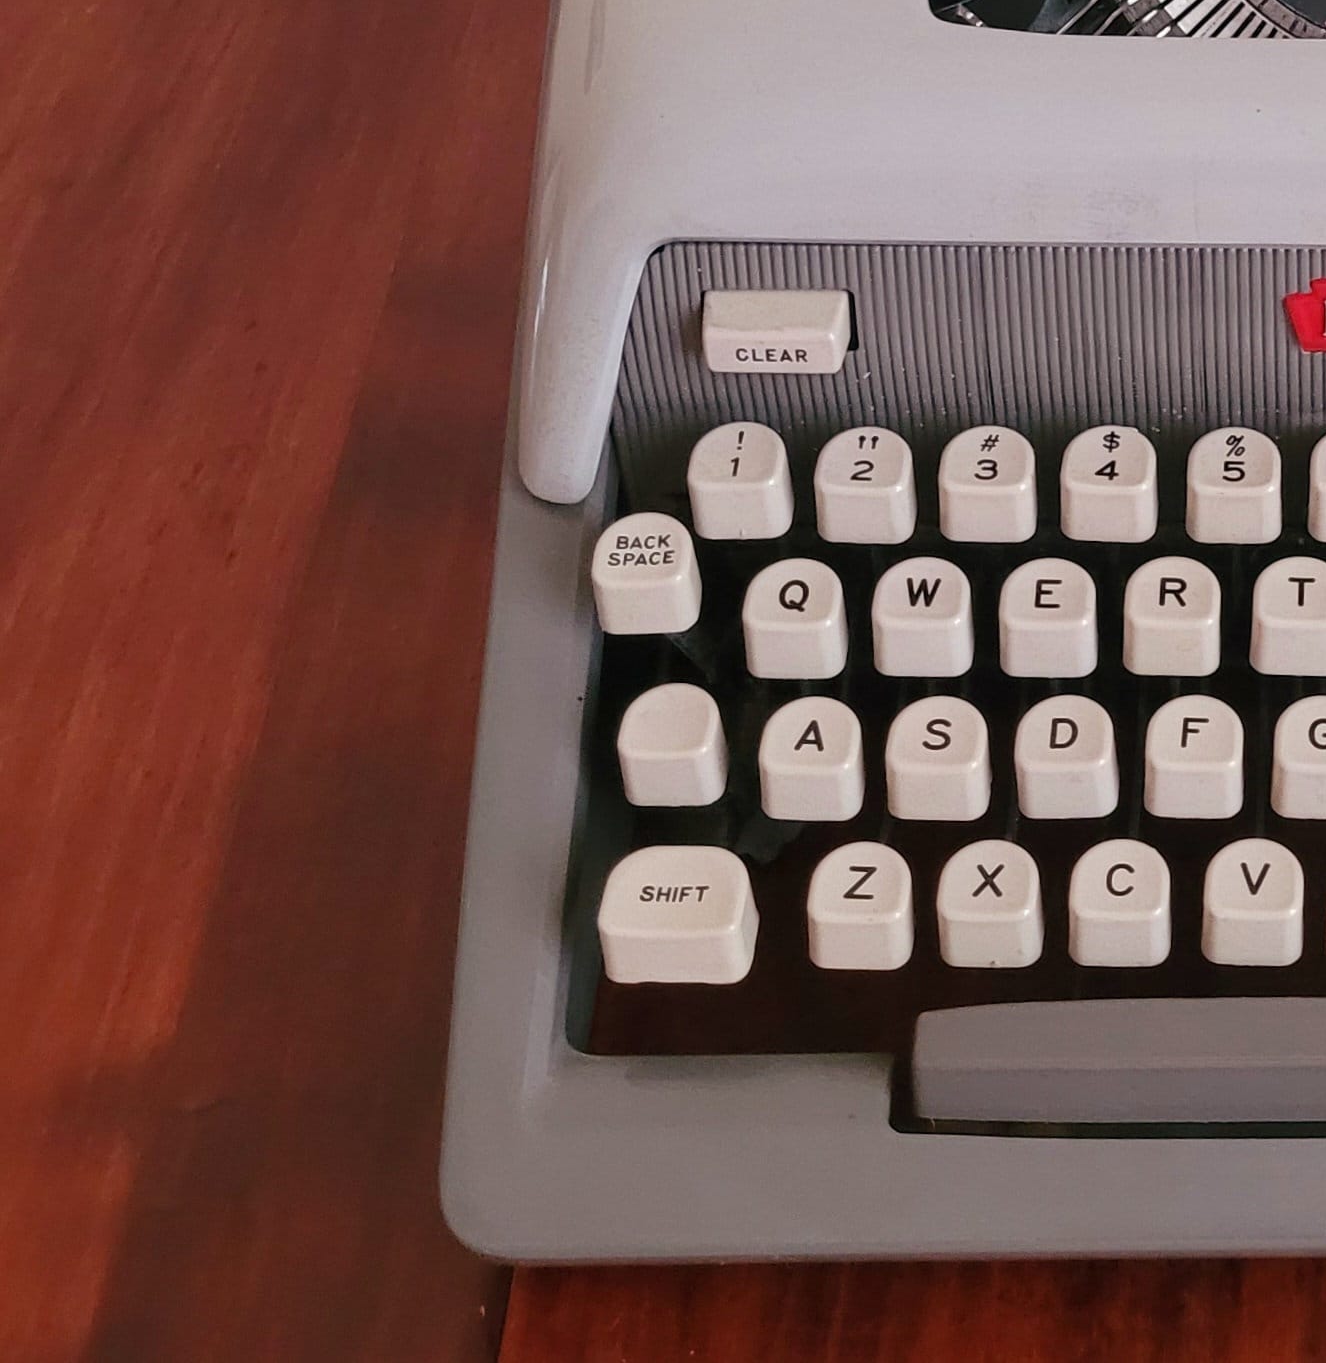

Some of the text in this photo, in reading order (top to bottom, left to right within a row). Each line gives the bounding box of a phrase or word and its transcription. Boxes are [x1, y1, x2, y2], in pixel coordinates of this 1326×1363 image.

[735, 348, 808, 363] CLEAR
[736, 430, 745, 451] !
[980, 434, 1000, 452] #
[1102, 430, 1121, 453] $
[1225, 434, 1246, 457] %
[730, 457, 740, 477] 1
[850, 460, 875, 482] 2
[974, 459, 998, 481] 3
[1094, 460, 1120, 481] 4
[1222, 460, 1246, 483] 5
[615, 534, 671, 549] BACK
[607, 550, 676, 567] SPACE
[778, 579, 810, 613] Q
[906, 577, 942, 608] W
[1034, 579, 1063, 609] E
[1158, 577, 1188, 608] R
[1287, 577, 1316, 607] T
[794, 719, 825, 752] A
[922, 718, 952, 751] S
[1049, 717, 1079, 750] D
[1180, 717, 1210, 749] F
[842, 865, 878, 900] Z
[971, 864, 1005, 898] X
[1105, 863, 1135, 897] C
[1240, 862, 1271, 896] V
[639, 885, 710, 903] SHIFT
